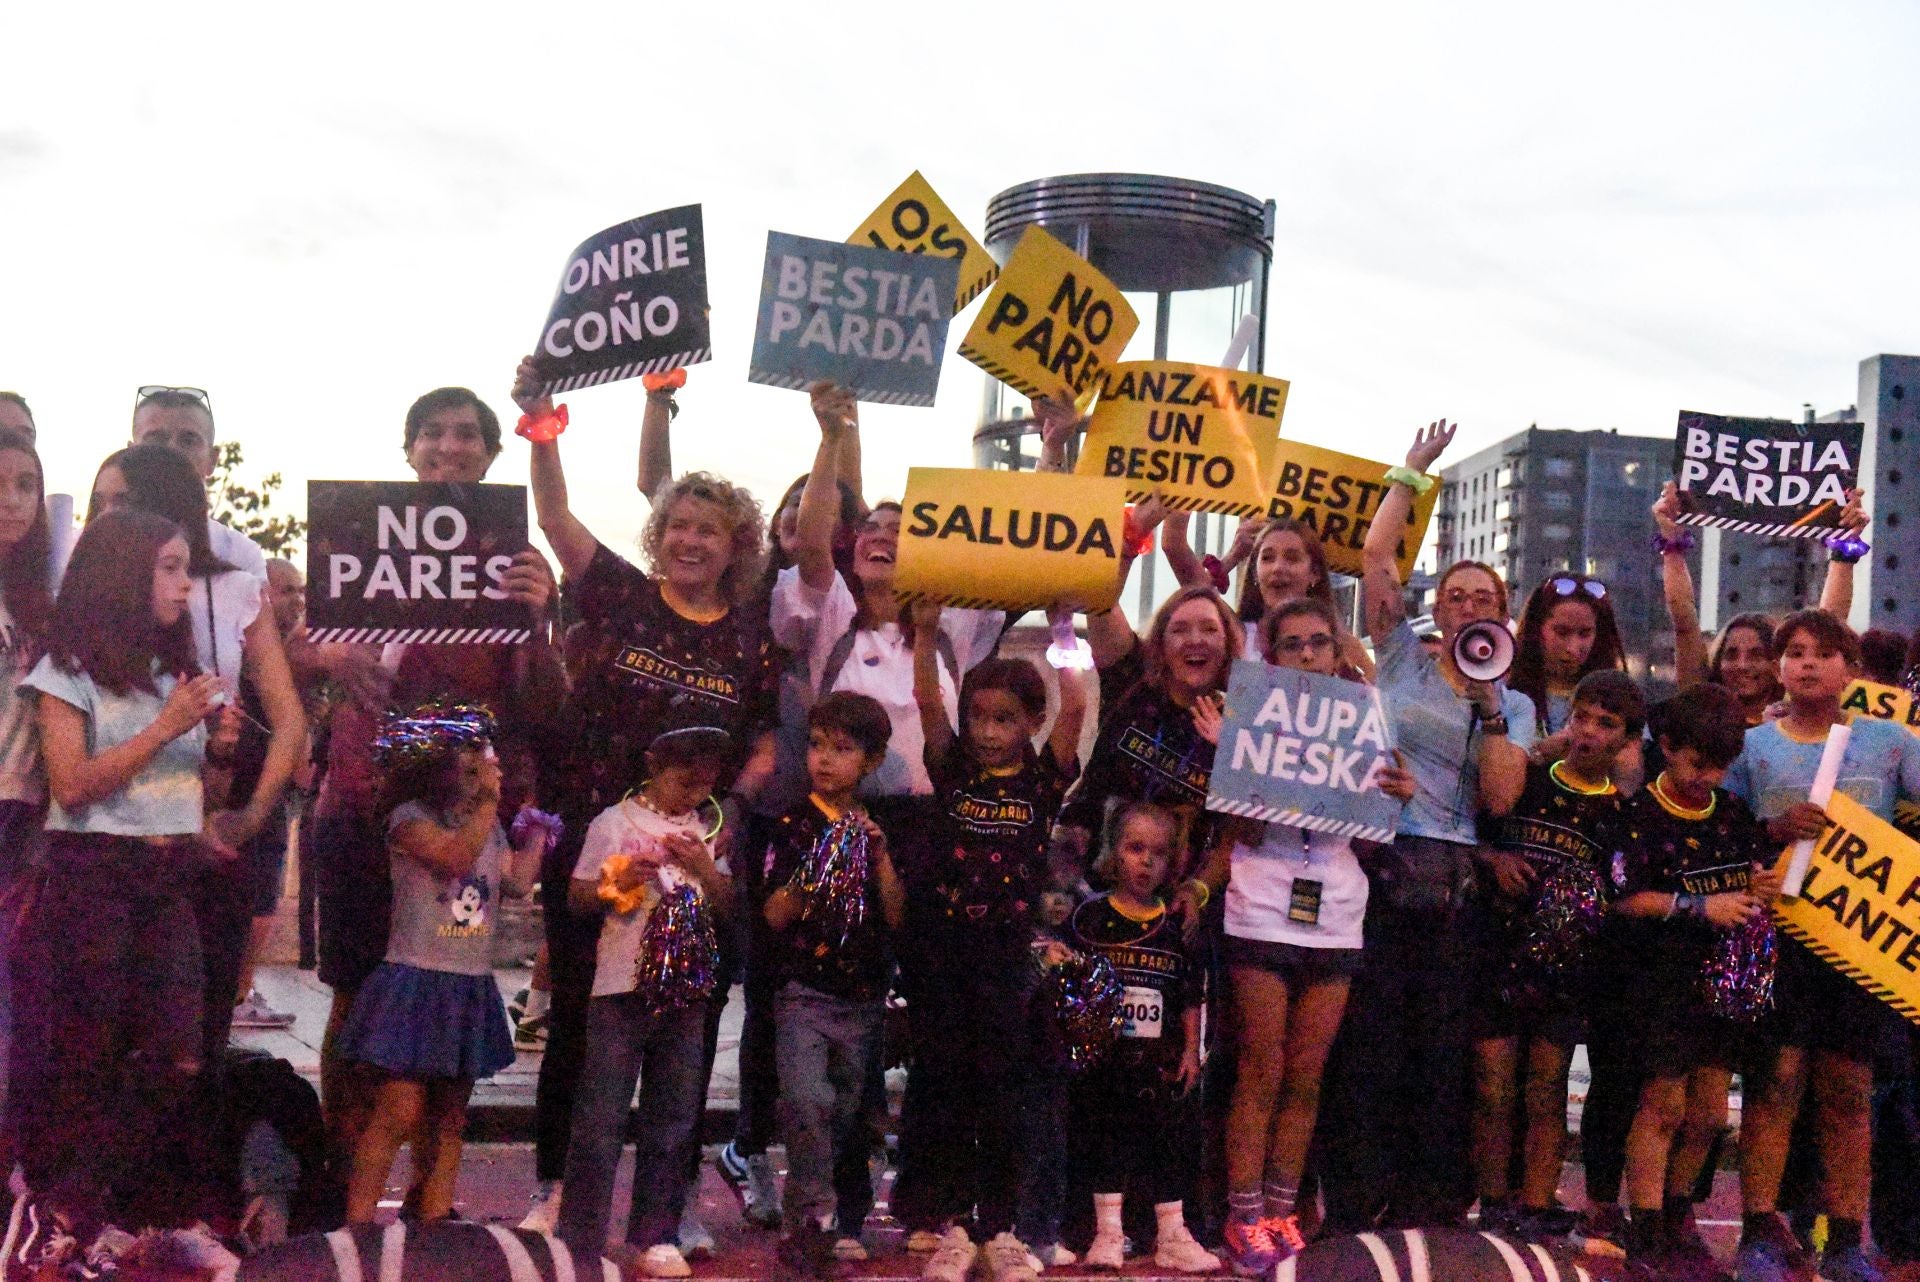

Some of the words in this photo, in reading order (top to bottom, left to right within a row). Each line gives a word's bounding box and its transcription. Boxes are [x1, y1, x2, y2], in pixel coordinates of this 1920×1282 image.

[778, 254, 940, 320] BESTIA
[1048, 271, 1113, 346] NO
[545, 290, 679, 358] COÑO
[769, 300, 935, 365] PARDA
[1098, 371, 1281, 420] LANZAME
[1147, 409, 1204, 446] UN
[1685, 427, 1851, 472] BESTIA
[1104, 446, 1235, 489] BESITO
[1679, 459, 1847, 507] PARDA
[377, 505, 468, 551] NO
[907, 501, 1117, 559] SALUDA
[329, 555, 514, 600] PARES
[626, 652, 678, 680] BESTIA
[1253, 687, 1386, 751] AUPA
[1820, 816, 1893, 895] IRA
[1799, 866, 1920, 973] LANTE
